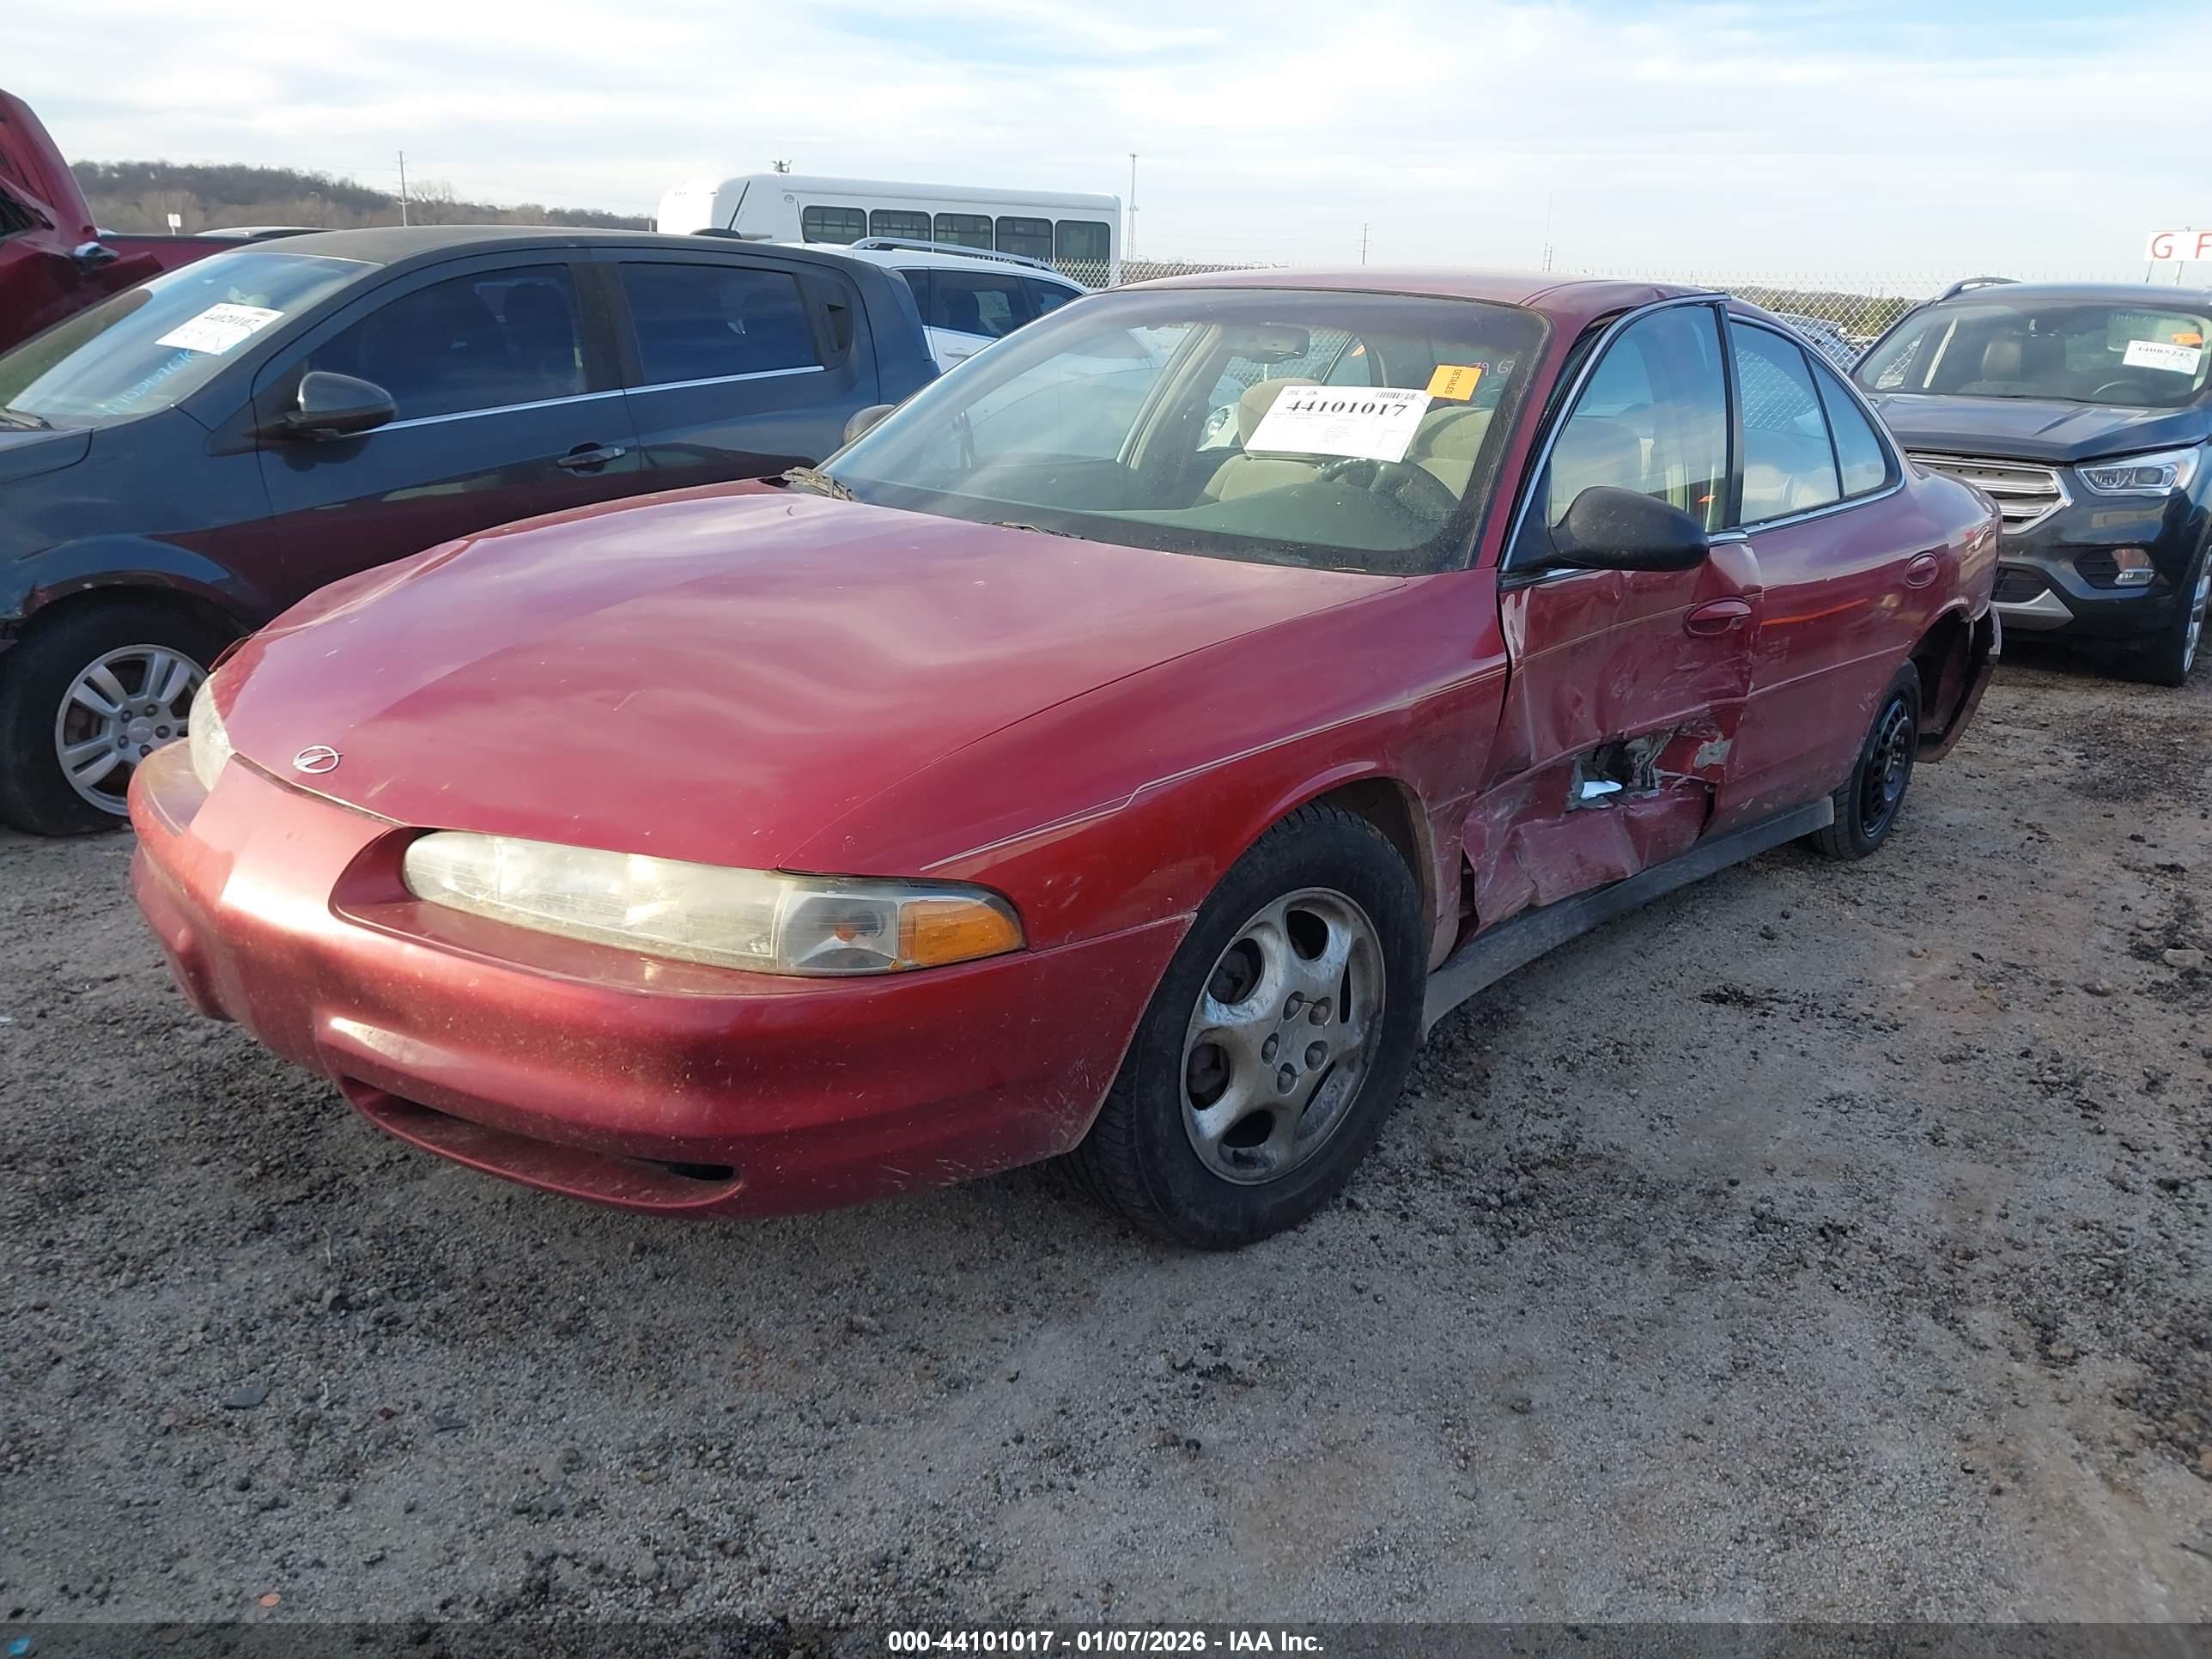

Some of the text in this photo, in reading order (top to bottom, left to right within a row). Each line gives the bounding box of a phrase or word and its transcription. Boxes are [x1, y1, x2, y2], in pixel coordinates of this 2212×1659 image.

[2152, 234, 2174, 259] G
[1444, 369, 1462, 395] DETAILED
[1286, 400, 1407, 417] 44101017
